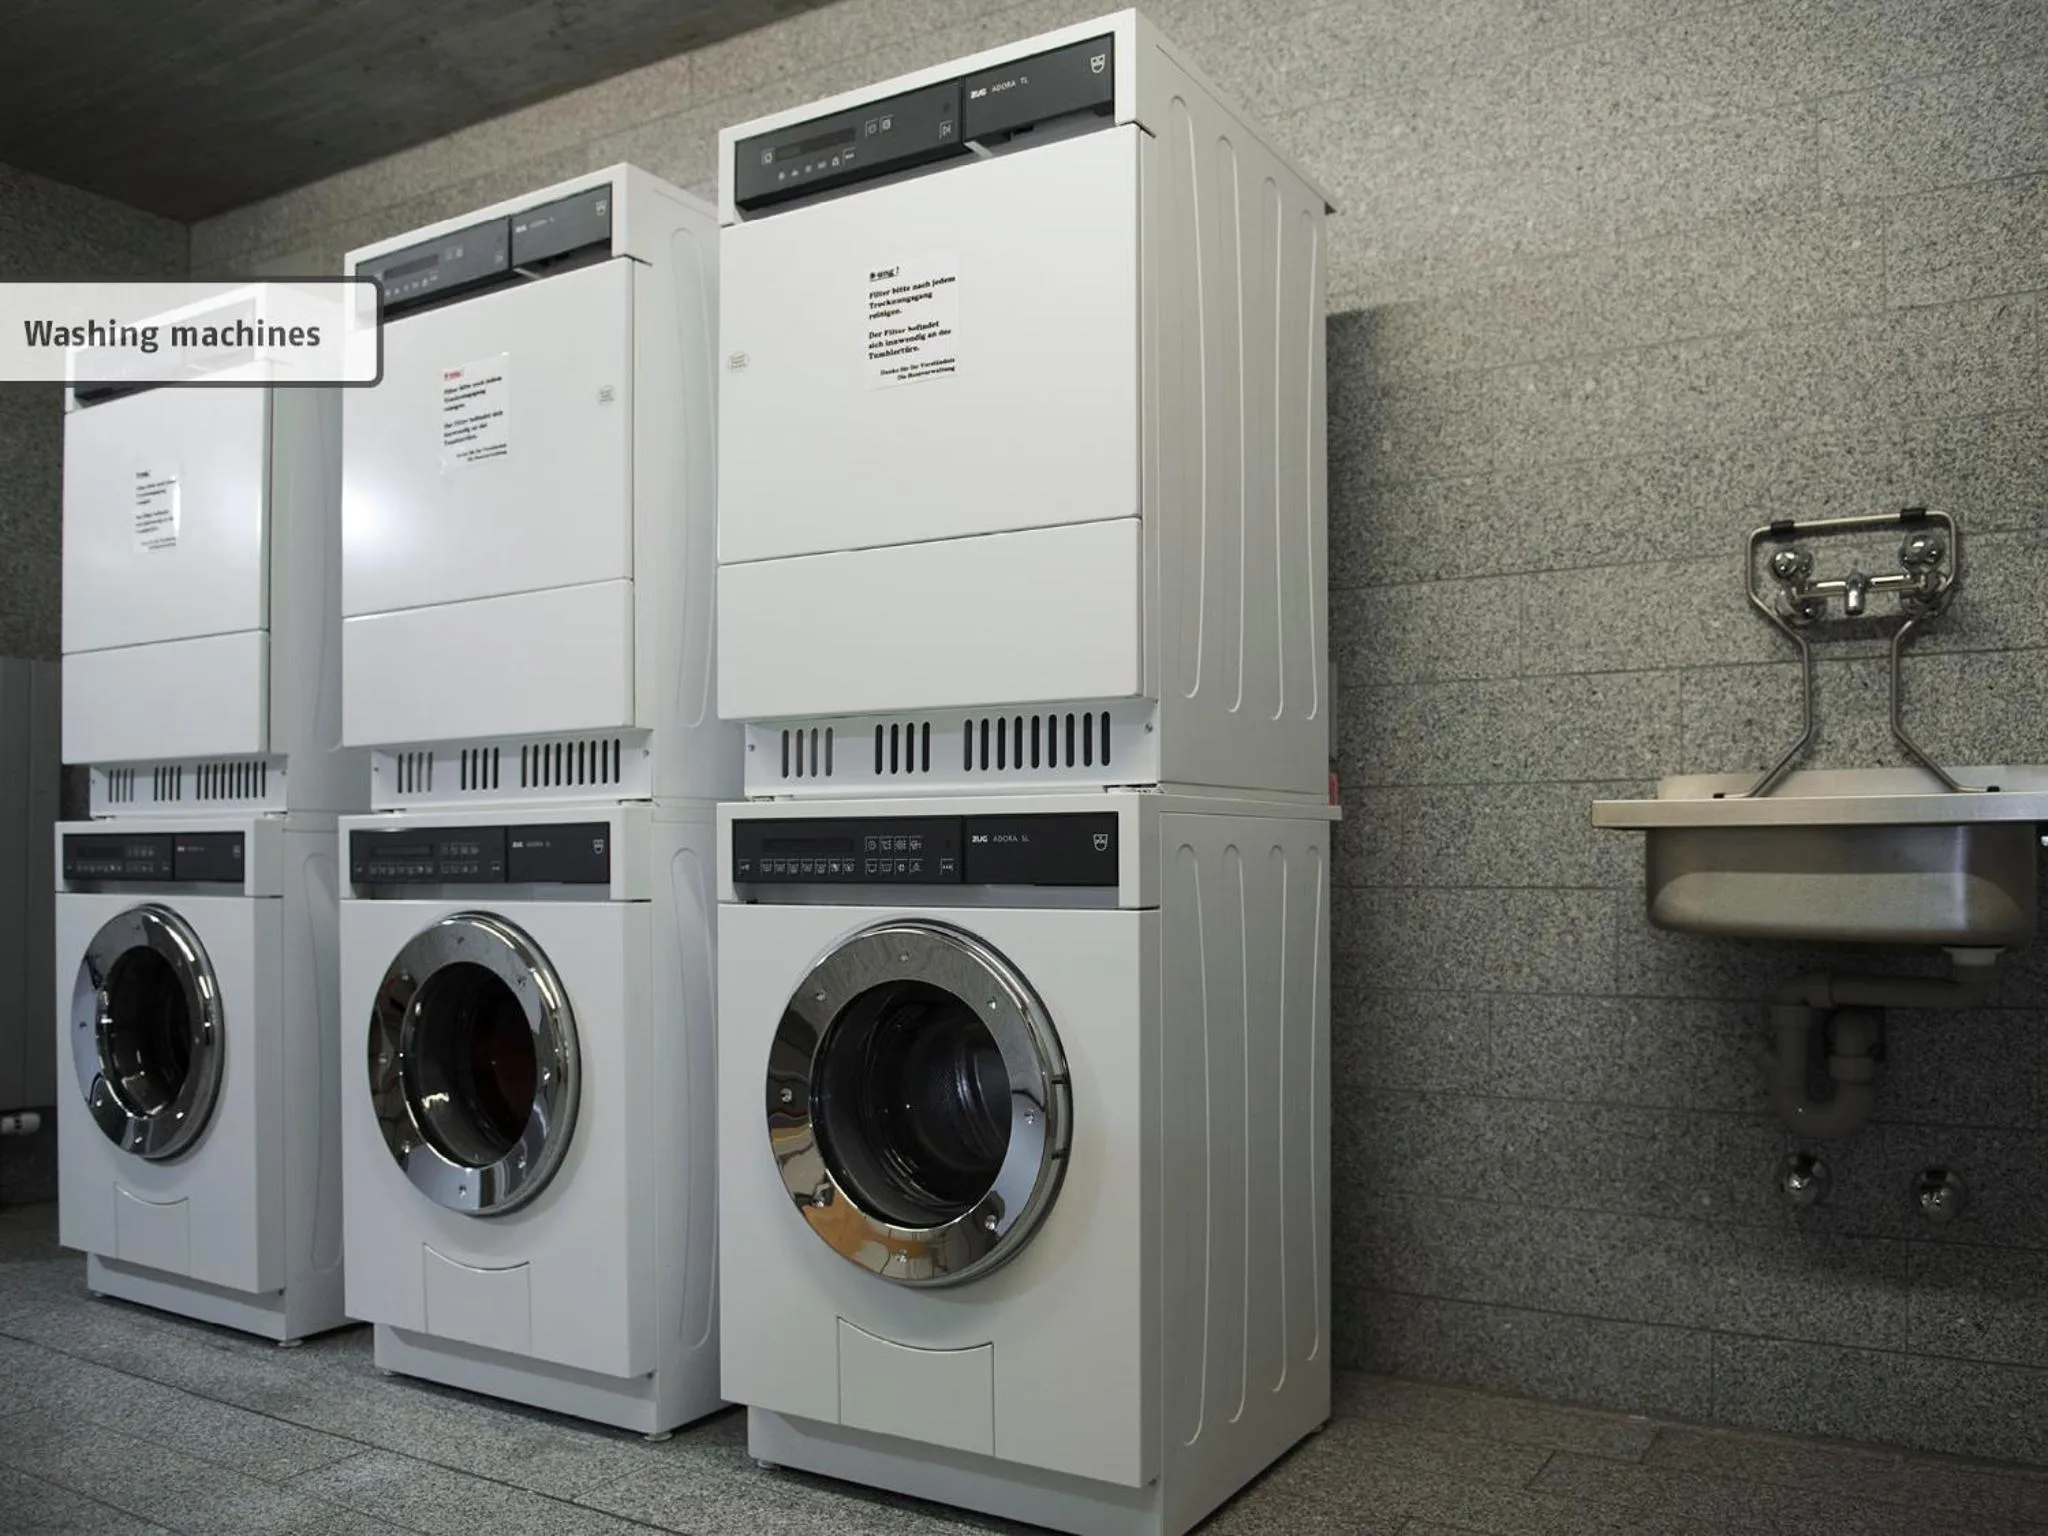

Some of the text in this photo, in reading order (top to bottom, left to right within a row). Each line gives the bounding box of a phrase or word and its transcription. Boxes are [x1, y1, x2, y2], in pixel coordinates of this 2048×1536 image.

[992, 80, 1016, 92] ADORA
[869, 276, 955, 300] Filter bitte nach jedem
[869, 308, 902, 320] reinigen.
[869, 320, 939, 339] Der Filter befindet
[869, 340, 884, 350] sich
[939, 329, 951, 337] der
[993, 834, 1018, 843] ADORA
